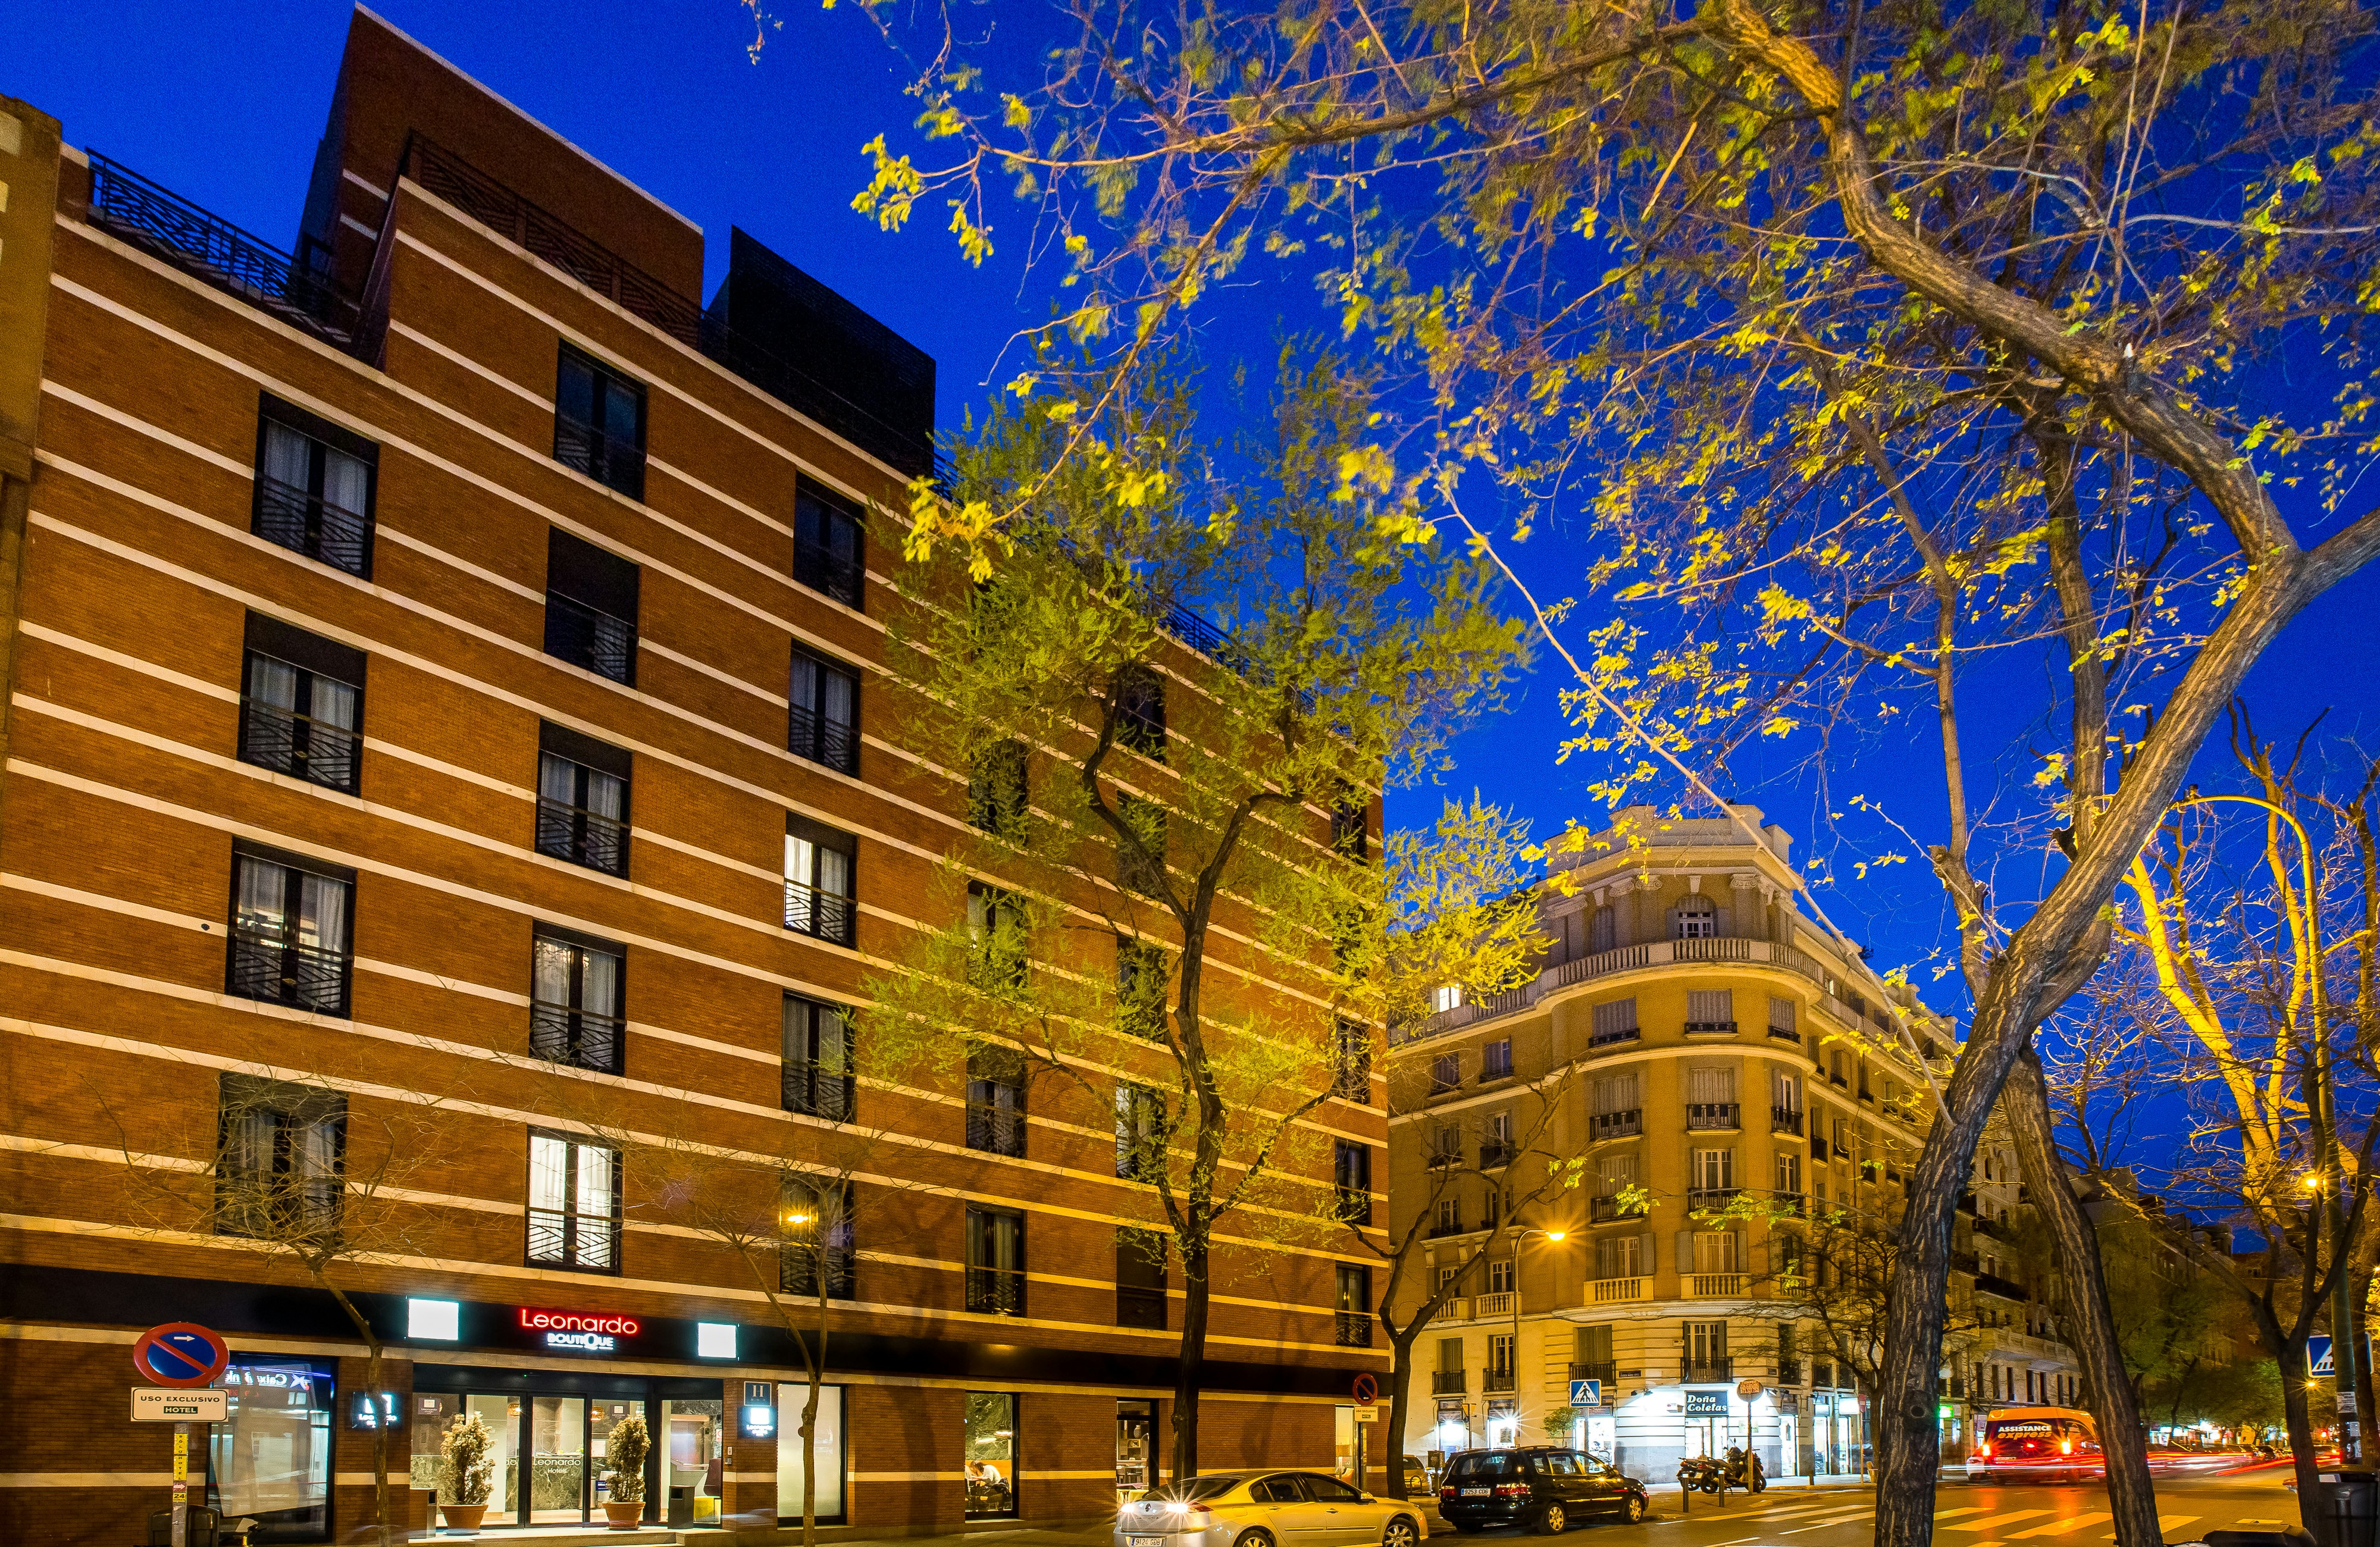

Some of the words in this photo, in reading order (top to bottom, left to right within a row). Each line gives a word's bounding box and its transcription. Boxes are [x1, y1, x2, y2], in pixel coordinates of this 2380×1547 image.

[522, 1309, 637, 1334] Leonardo
[547, 1333, 613, 1350] BOUTIQUE
[753, 1385, 764, 1397] H
[1687, 1395, 1716, 1403] Doña
[1687, 1403, 1727, 1411] Coletas
[1997, 1432, 2052, 1440] express
